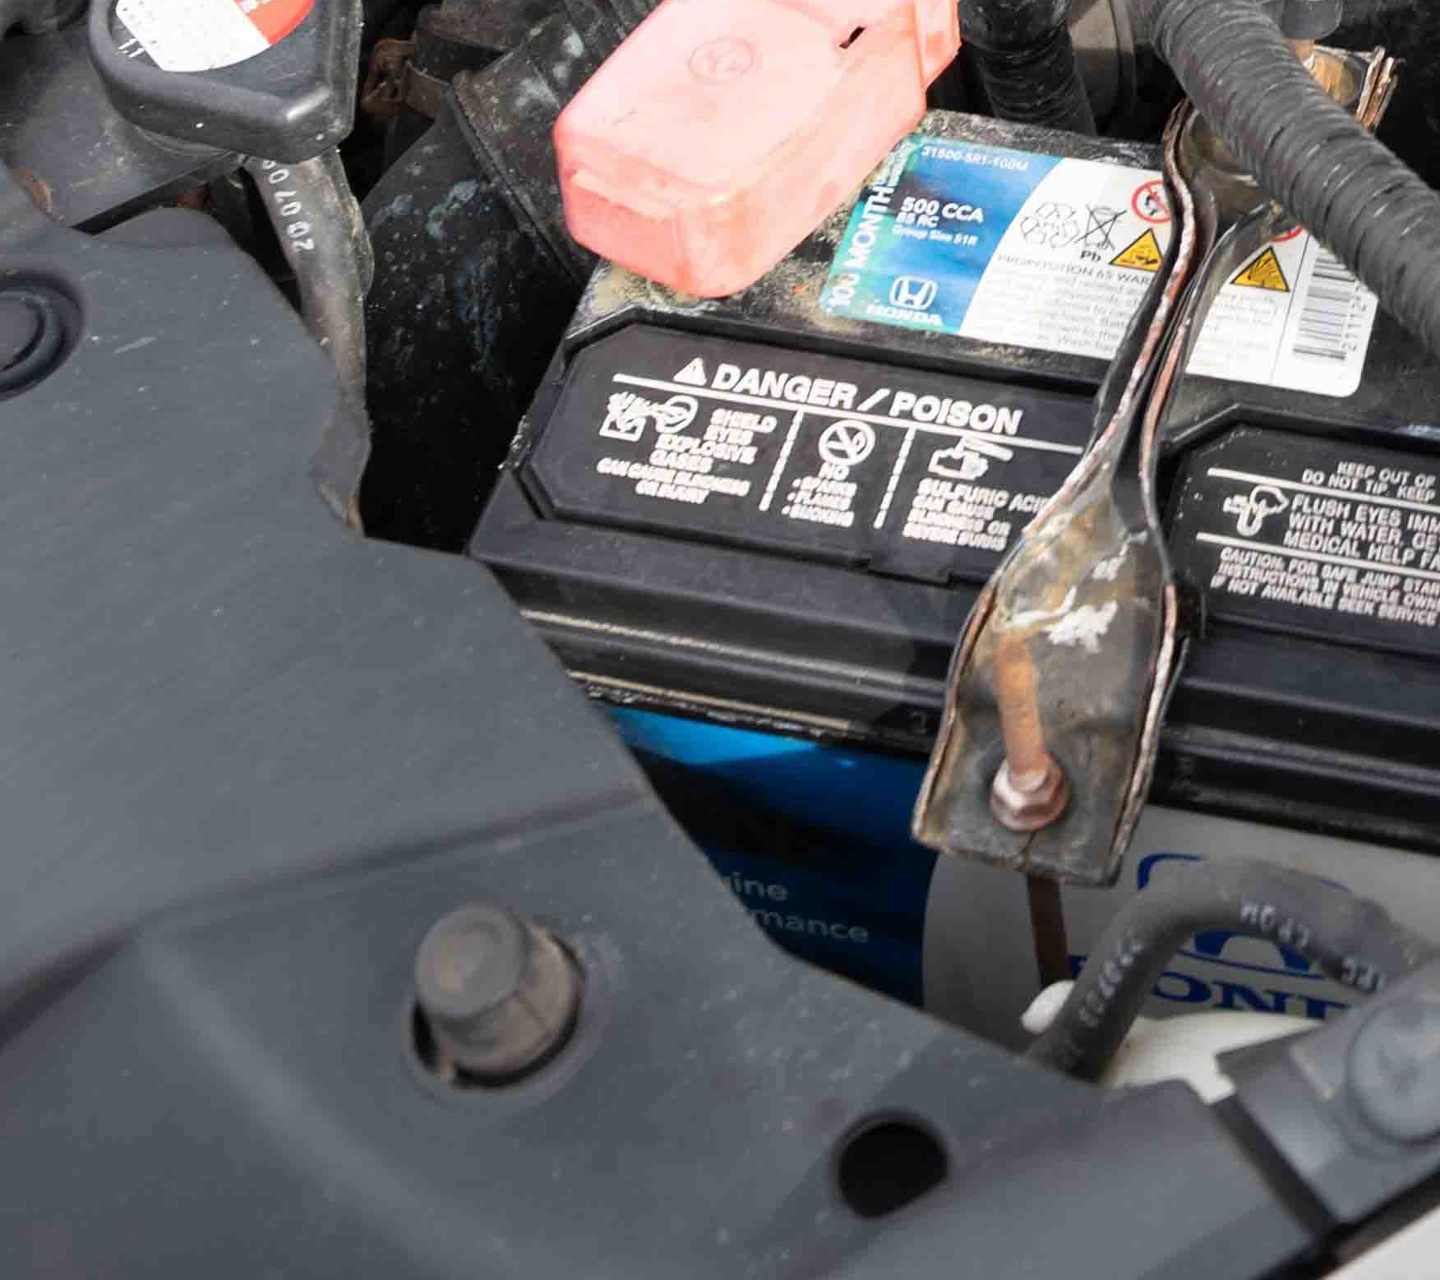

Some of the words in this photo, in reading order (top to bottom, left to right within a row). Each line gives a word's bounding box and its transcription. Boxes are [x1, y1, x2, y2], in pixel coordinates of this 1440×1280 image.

[899, 195, 939, 216] 500
[941, 200, 984, 224] CCA
[1079, 249, 1103, 264] Pb
[711, 363, 858, 410] DANGER
[889, 391, 1024, 435] POISON
[1302, 469, 1325, 486] DO
[1328, 472, 1360, 492] NOT
[1396, 484, 1436, 505] KEEP
[1337, 461, 1376, 481] KEEP
[1378, 467, 1409, 486] OUT
[1414, 473, 1436, 489] OF
[918, 478, 1009, 508] SULFURIC
[1289, 512, 1334, 536] WITH
[1291, 493, 1352, 519] FLUSH
[1357, 503, 1402, 527] EYES
[1283, 530, 1361, 558] MEDICAL
[1367, 545, 1416, 568] HELP
[1218, 562, 1320, 595] INSTRUCTIONS
[1323, 578, 1340, 597] IN
[1342, 582, 1402, 608] VEHICLE
[1289, 558, 1318, 577] FOR
[1321, 563, 1358, 584] SAFE
[1360, 570, 1401, 590] JUMP
[1210, 575, 1226, 590] IF
[1228, 578, 1259, 596] NOT
[1261, 584, 1335, 611] AVAILABLE
[1338, 595, 1375, 616] SEEK
[1378, 601, 1438, 627] SERVICE
